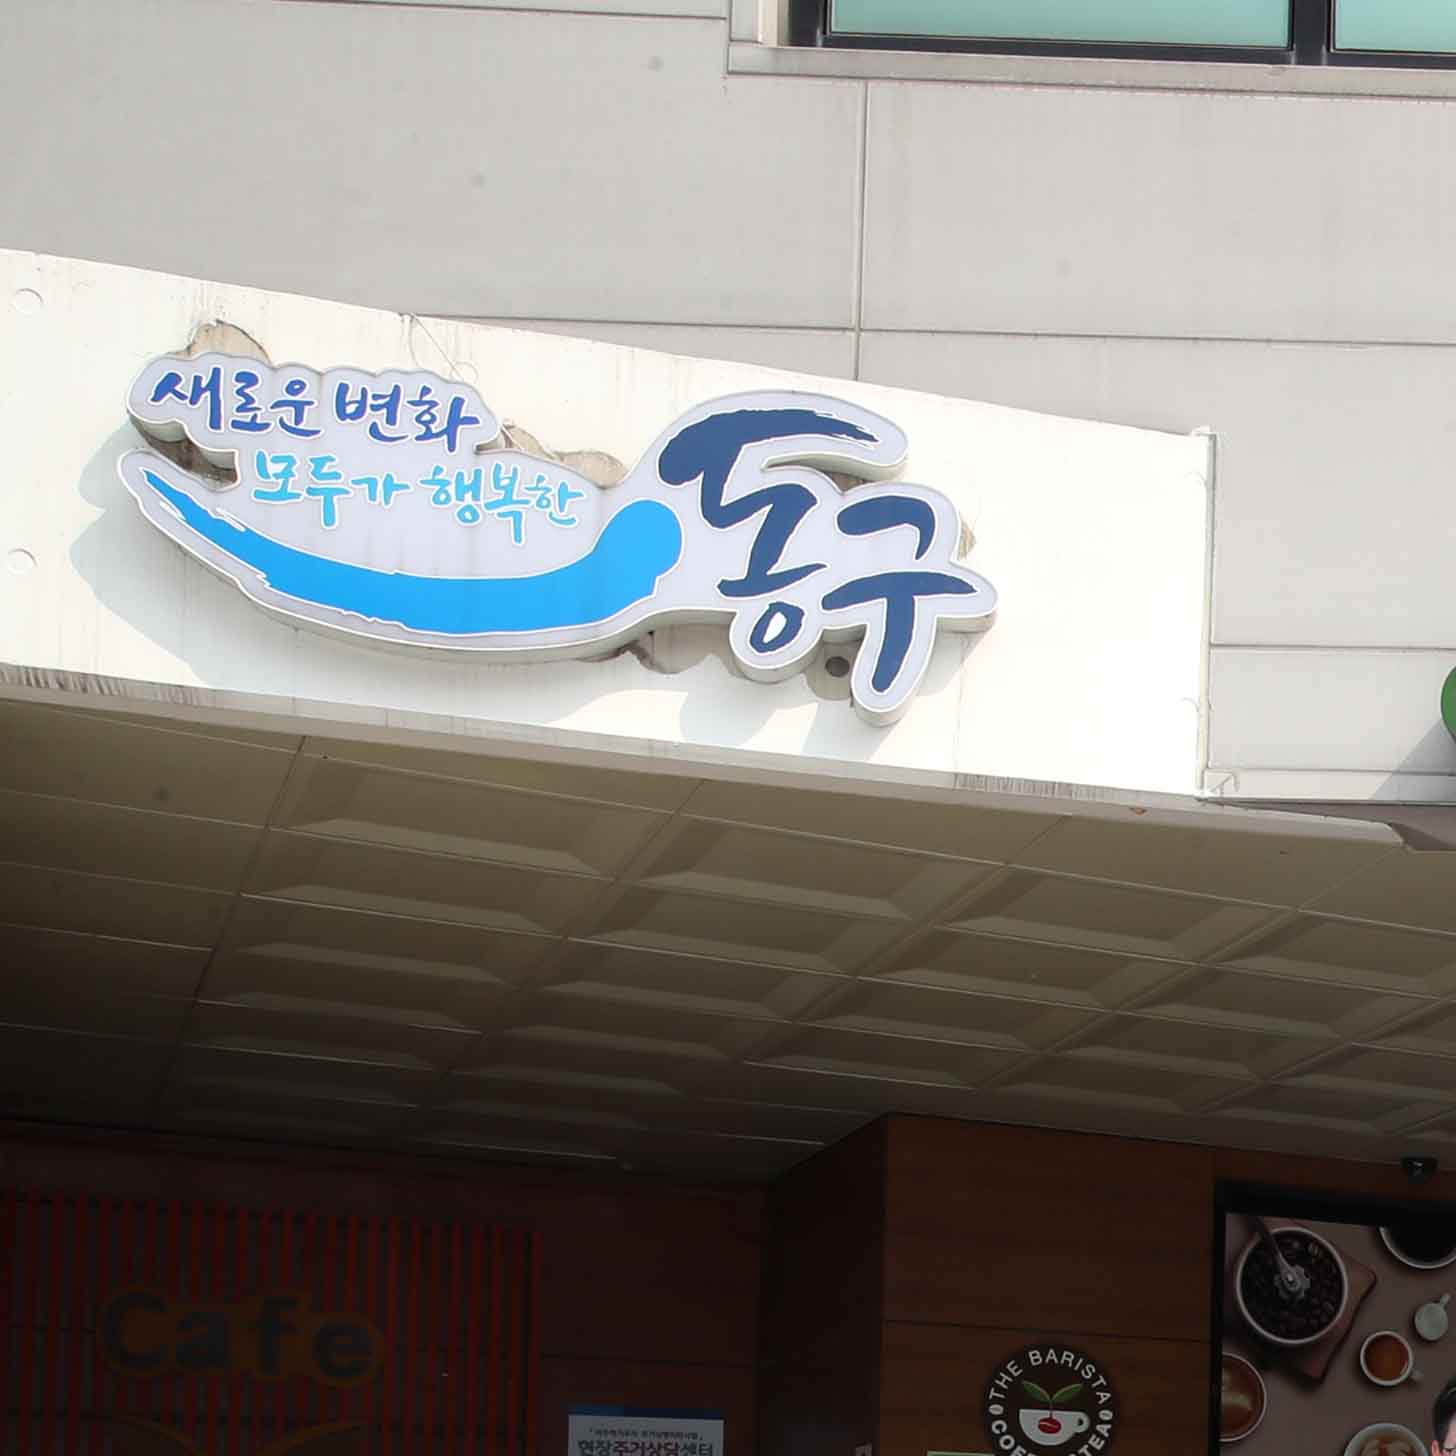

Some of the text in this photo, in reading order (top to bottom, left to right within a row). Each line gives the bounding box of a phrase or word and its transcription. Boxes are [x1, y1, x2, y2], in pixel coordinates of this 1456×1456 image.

[153, 367, 484, 453] 새로운 변화
[251, 450, 586, 546] 모두가 행복한
[657, 407, 979, 694] 동구
[104, 1291, 378, 1381] Cafe
[989, 1348, 1112, 1404] THE BARISTA
